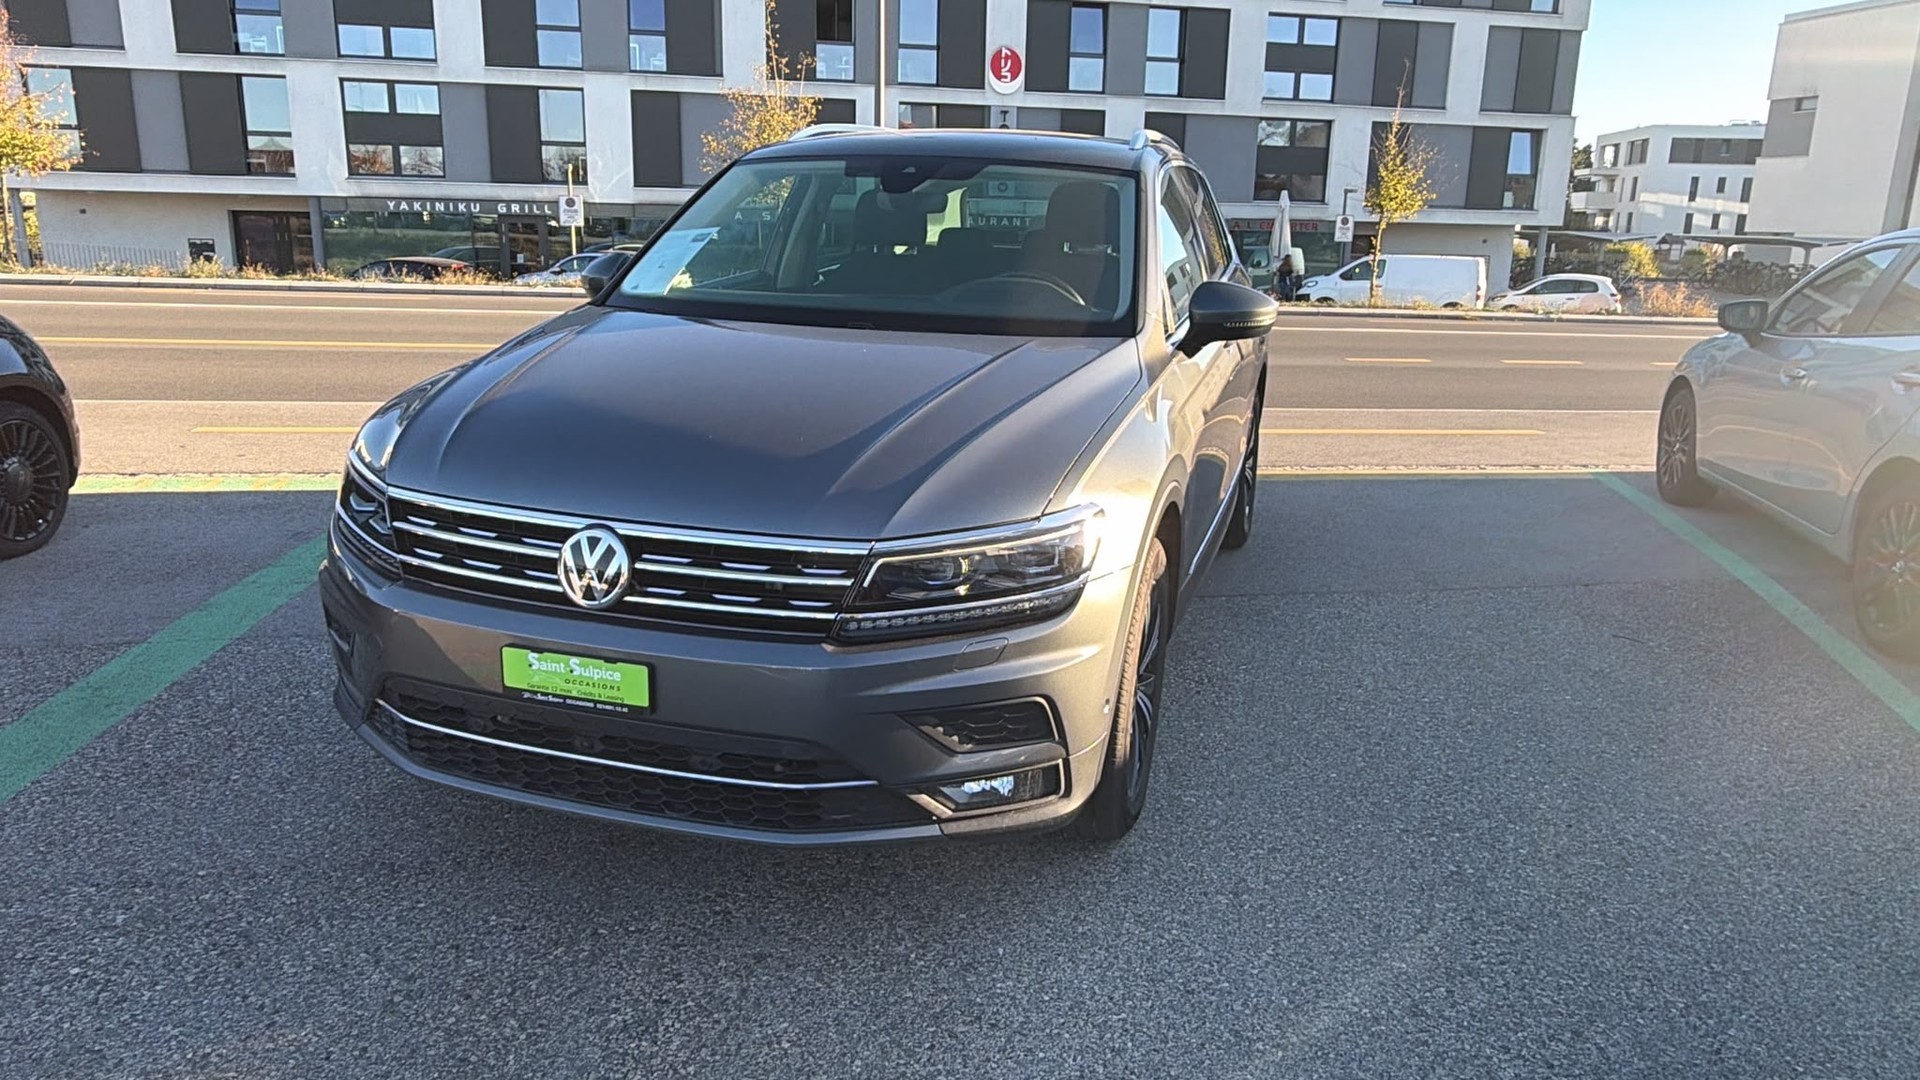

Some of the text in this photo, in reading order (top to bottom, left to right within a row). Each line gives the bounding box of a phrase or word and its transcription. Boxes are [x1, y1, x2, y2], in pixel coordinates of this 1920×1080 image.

[387, 201, 552, 214] YAKINIKU GRILL
[564, 679, 621, 691] OCCASIONS
